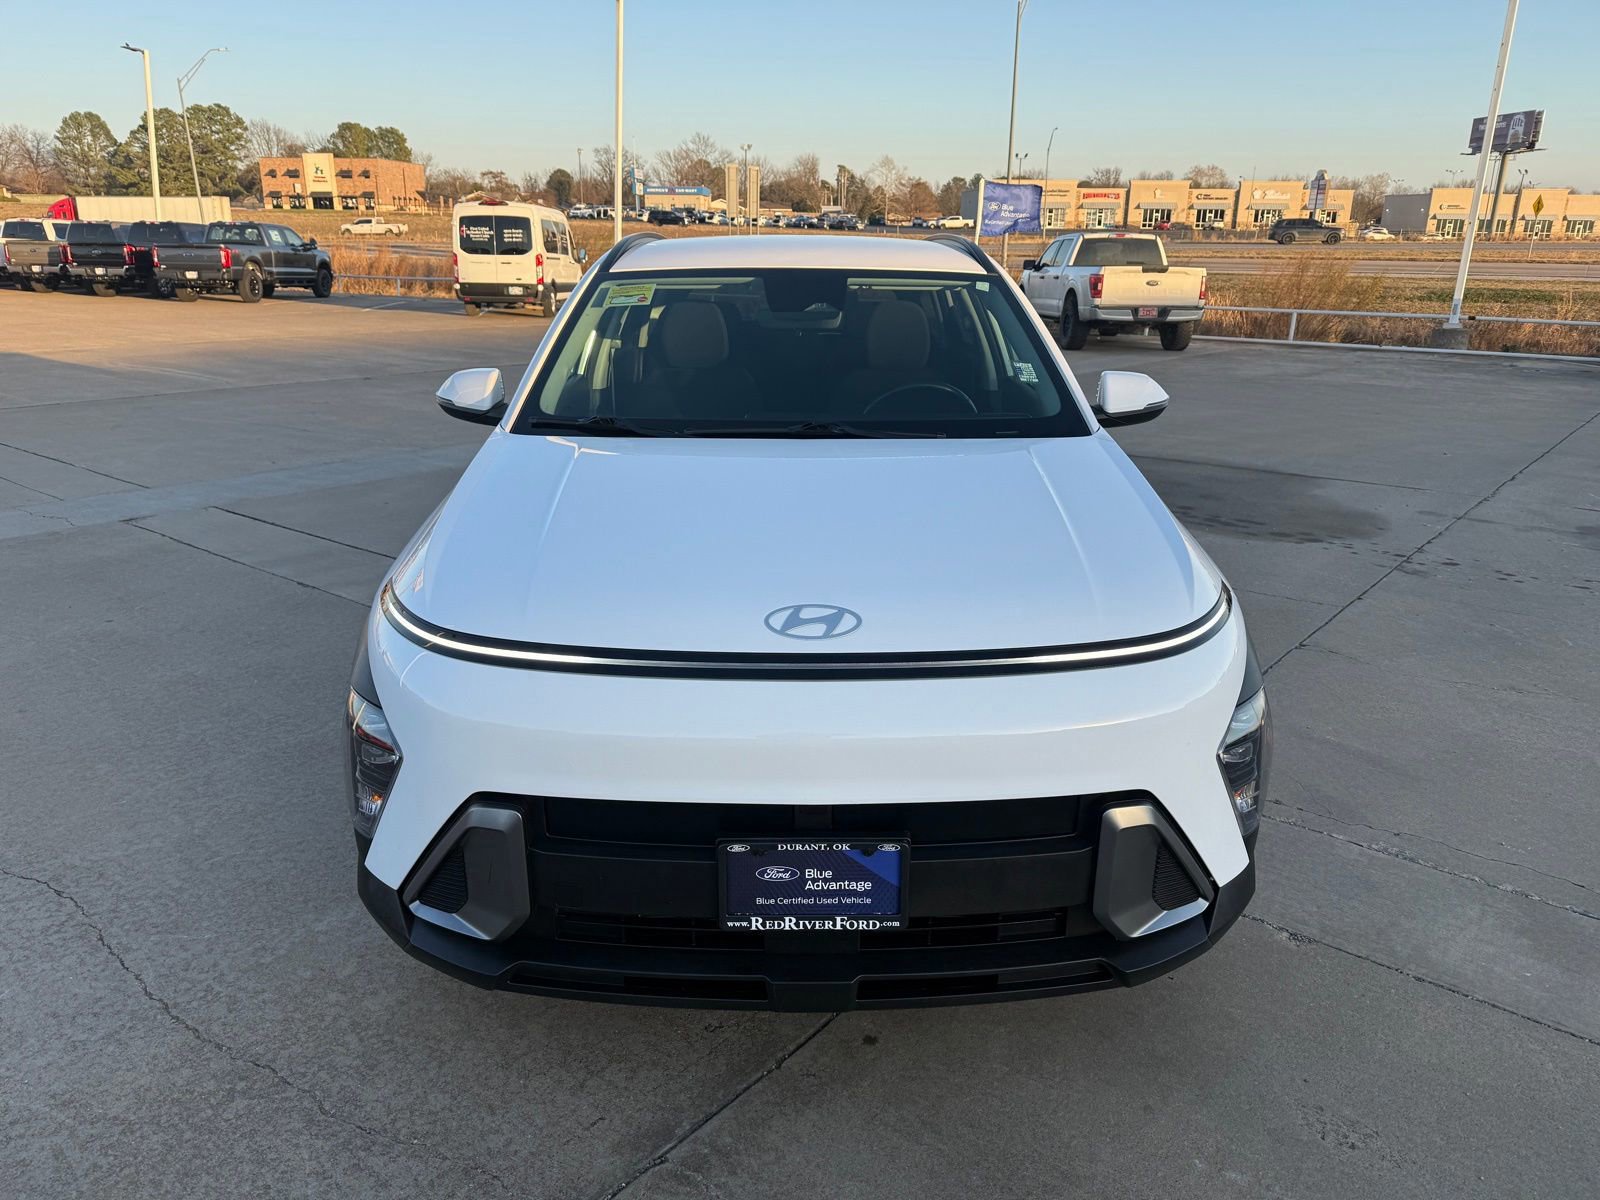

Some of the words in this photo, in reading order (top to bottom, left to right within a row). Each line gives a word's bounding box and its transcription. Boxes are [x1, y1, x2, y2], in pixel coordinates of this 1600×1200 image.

[777, 843, 830, 851] DURANT,
[832, 843, 851, 851] OK
[763, 867, 792, 879] Ford
[805, 868, 833, 879] Blue
[804, 879, 872, 892] Advantage
[755, 897, 776, 905] Blue
[777, 896, 815, 905] Certified
[816, 896, 839, 904] Used
[840, 896, 872, 904] Vehicle
